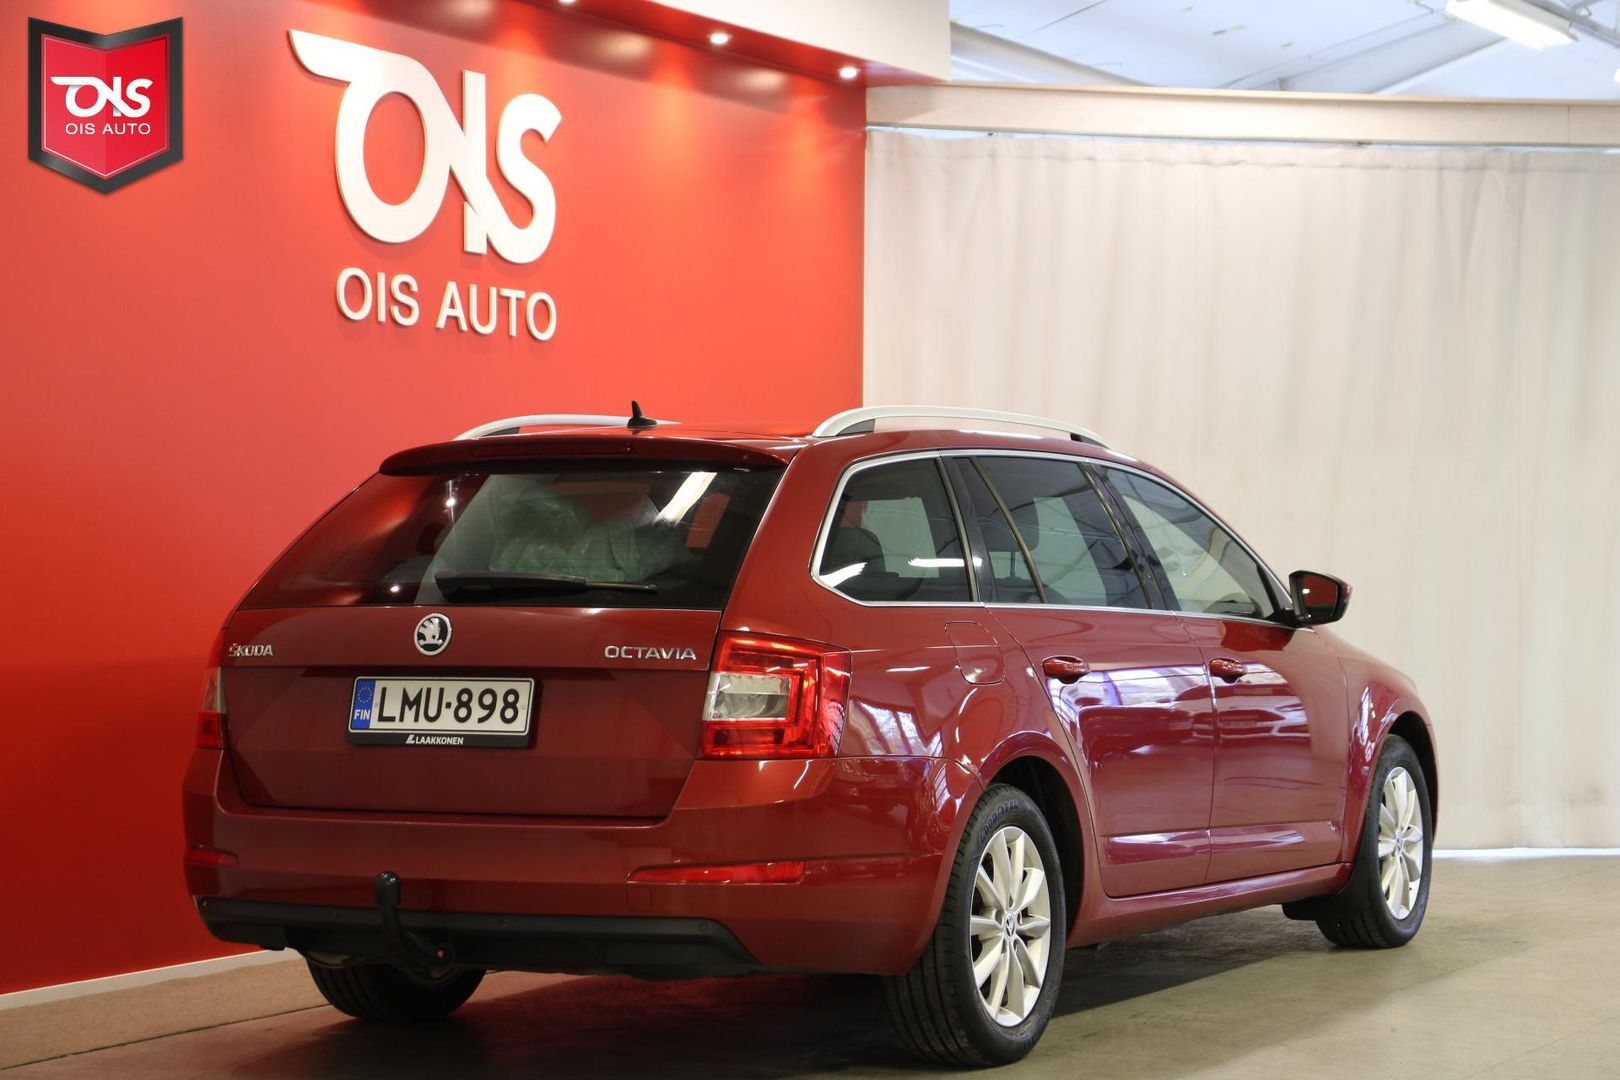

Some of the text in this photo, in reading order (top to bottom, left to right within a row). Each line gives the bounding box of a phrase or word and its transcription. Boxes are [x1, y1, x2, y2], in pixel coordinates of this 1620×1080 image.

[288, 28, 563, 265] OIS
[336, 266, 558, 342] OIS AUTO
[604, 645, 697, 660] OCTAVIA
[353, 709, 371, 721] FIN
[377, 686, 520, 725] LMU-898
